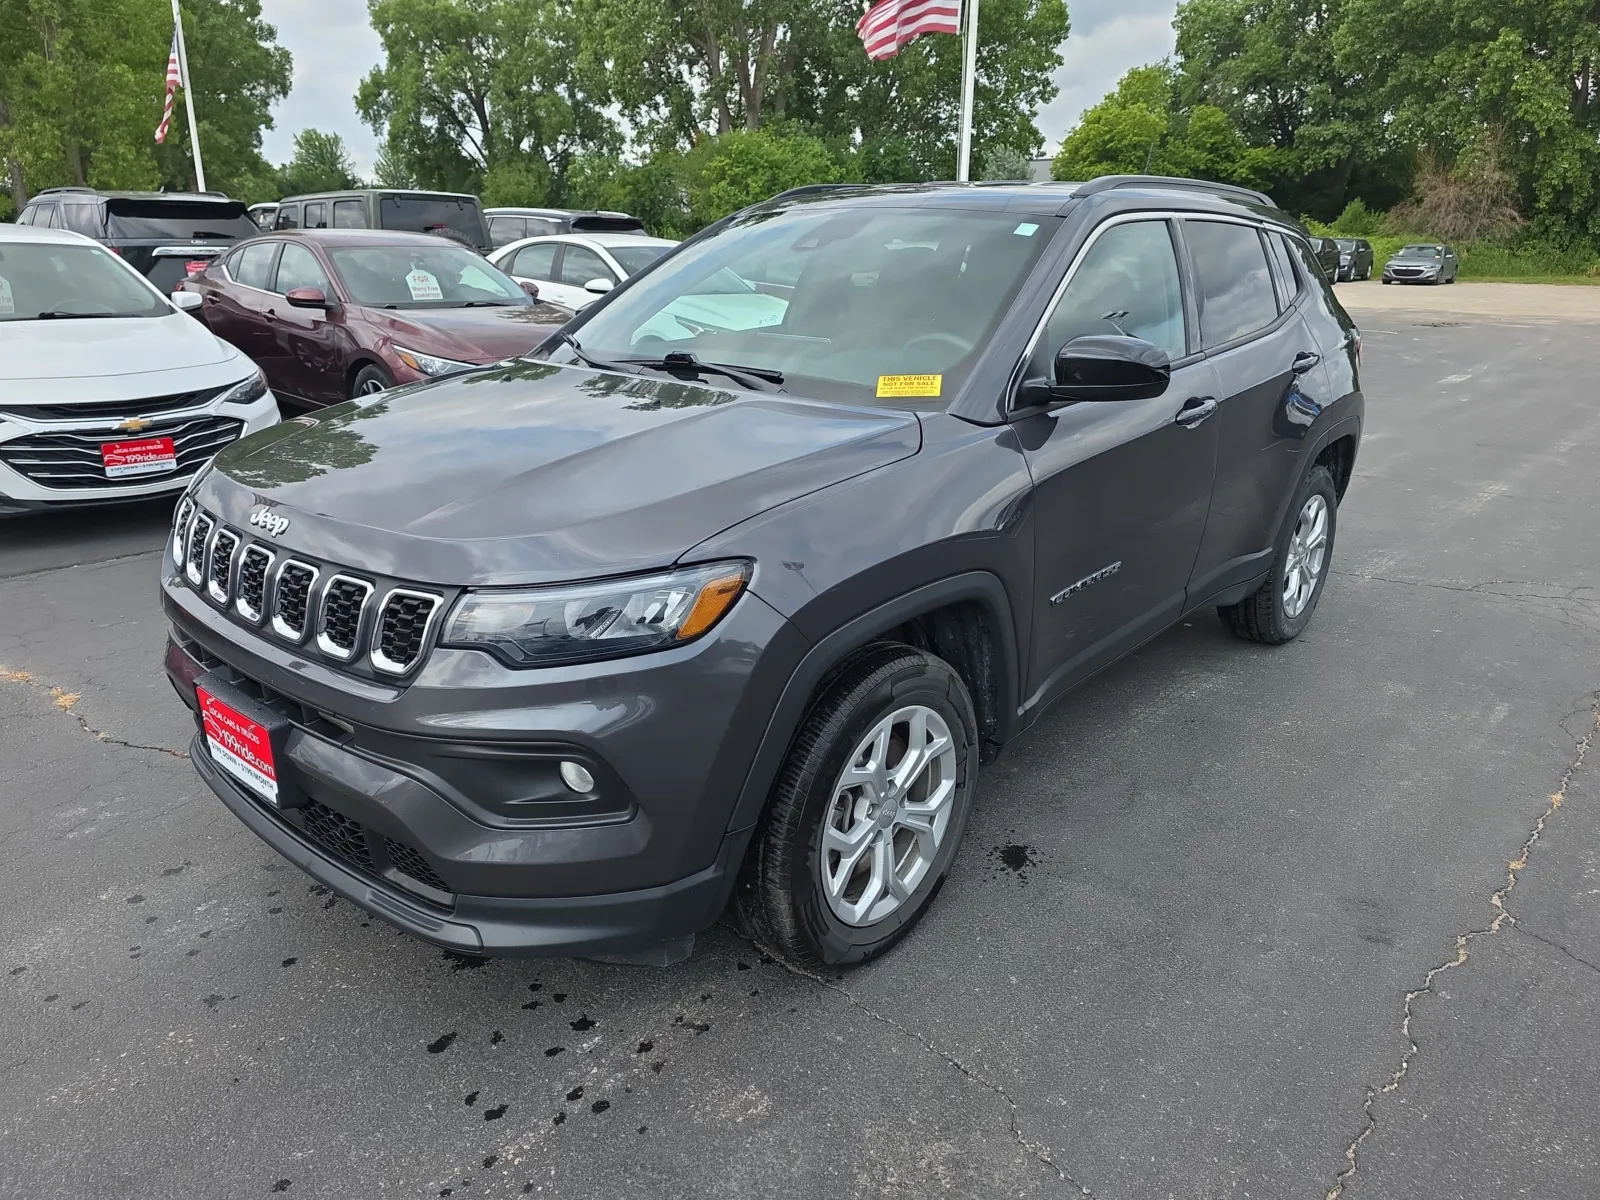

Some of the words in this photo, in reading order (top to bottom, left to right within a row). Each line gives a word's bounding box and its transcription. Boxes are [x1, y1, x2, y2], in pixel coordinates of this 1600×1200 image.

[125, 452, 174, 464] 199ride.com
[250, 506, 290, 538] Jeep
[1049, 561, 1122, 607] COMPASS
[208, 705, 224, 721] LOCAL
[223, 716, 236, 730] CARS
[240, 726, 260, 745] TRUCKS
[221, 729, 275, 777] 199ride.com
